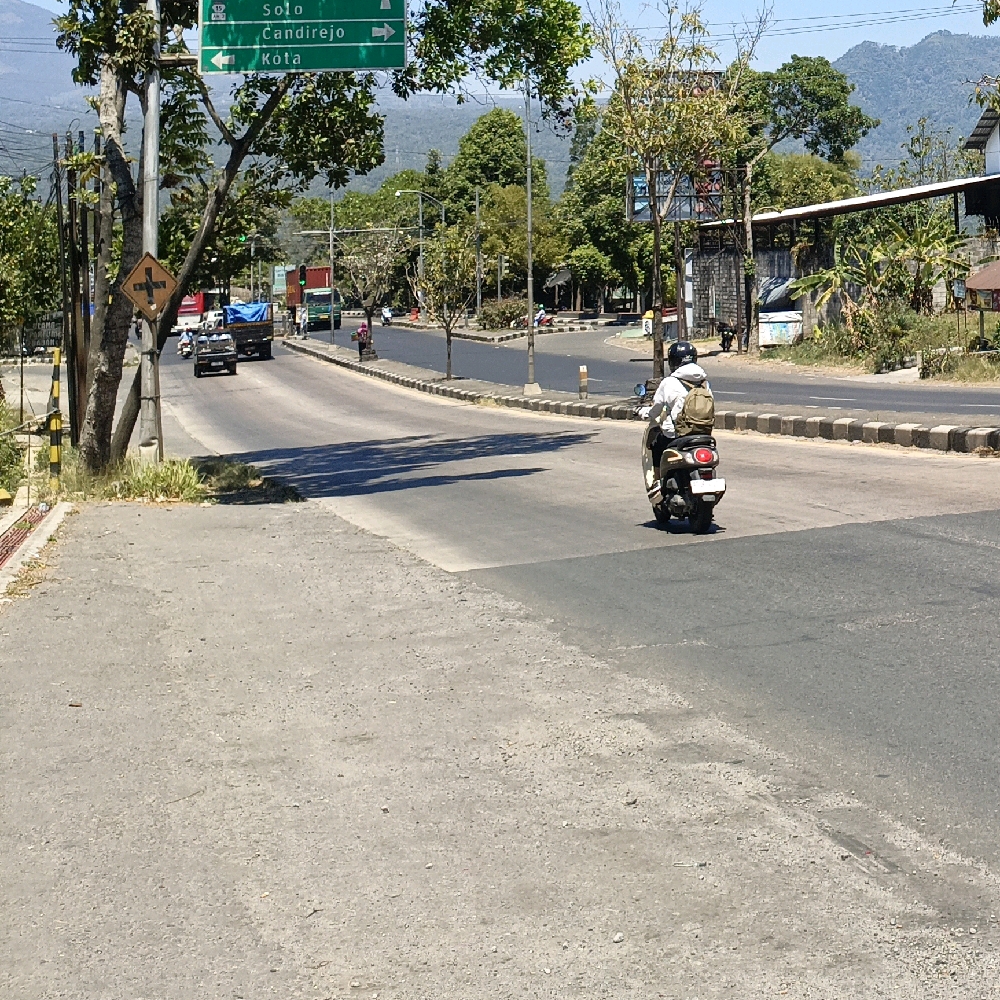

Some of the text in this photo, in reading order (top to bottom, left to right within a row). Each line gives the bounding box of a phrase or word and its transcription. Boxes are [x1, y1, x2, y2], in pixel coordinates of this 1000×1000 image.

[262, 3, 303, 17] Solo
[262, 24, 345, 42] Candirejo
[261, 52, 301, 65] Kota
